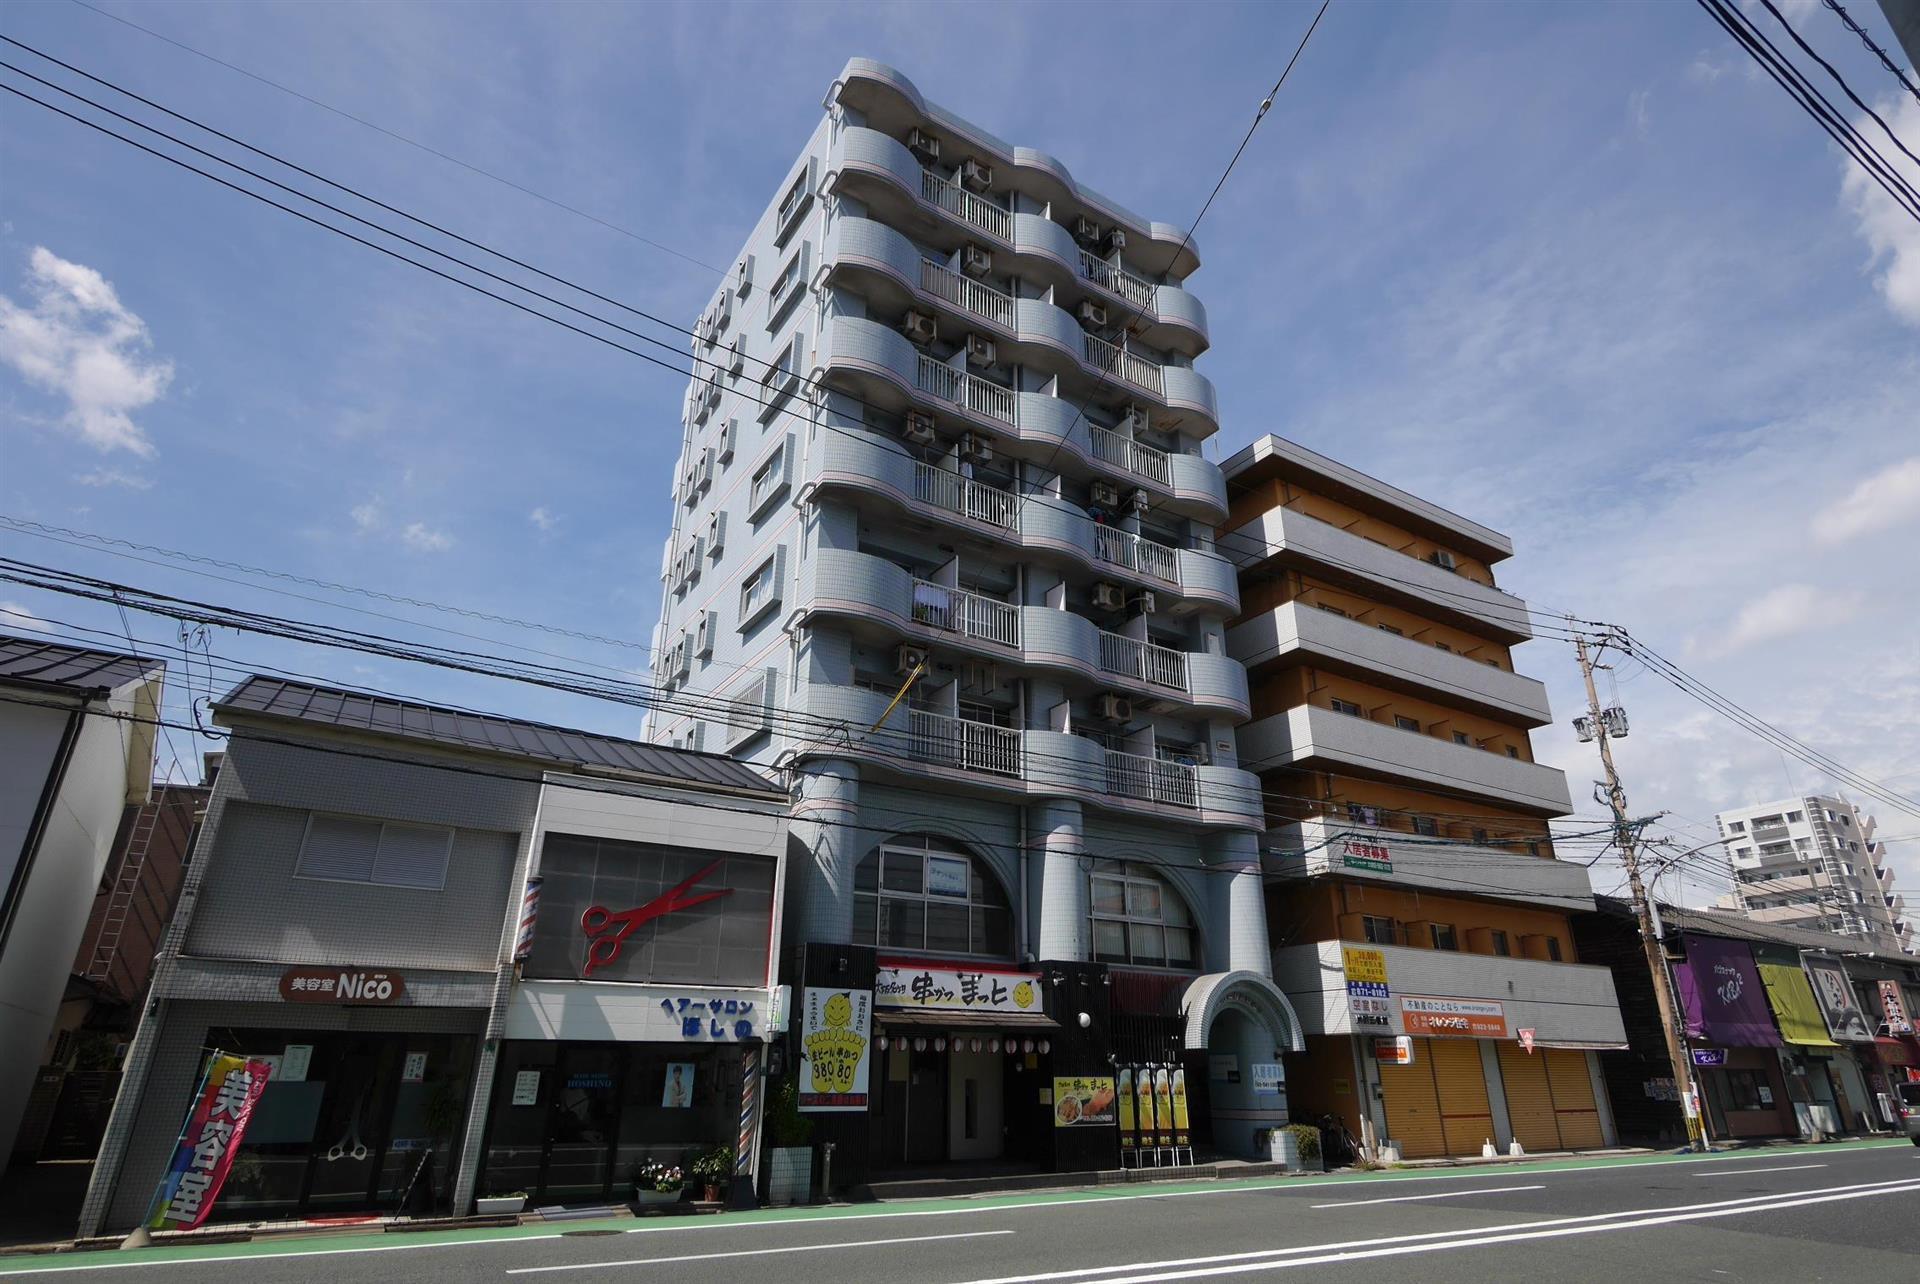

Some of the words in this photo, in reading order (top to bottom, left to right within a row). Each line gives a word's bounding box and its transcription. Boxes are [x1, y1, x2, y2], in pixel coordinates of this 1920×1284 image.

[291, 978, 335, 991] 美容室
[336, 973, 392, 999] Nico
[912, 971, 954, 1005] 串かつ
[661, 999, 753, 1015] ヘアーサロン
[1407, 1000, 1459, 1012] 不動産のことなら
[682, 1017, 752, 1037] ほしの
[1428, 1016, 1469, 1029] オレンジ住宅
[812, 1047, 835, 1062] 生ビール
[837, 1063, 851, 1079] 80
[164, 1068, 253, 1223] 美容室
